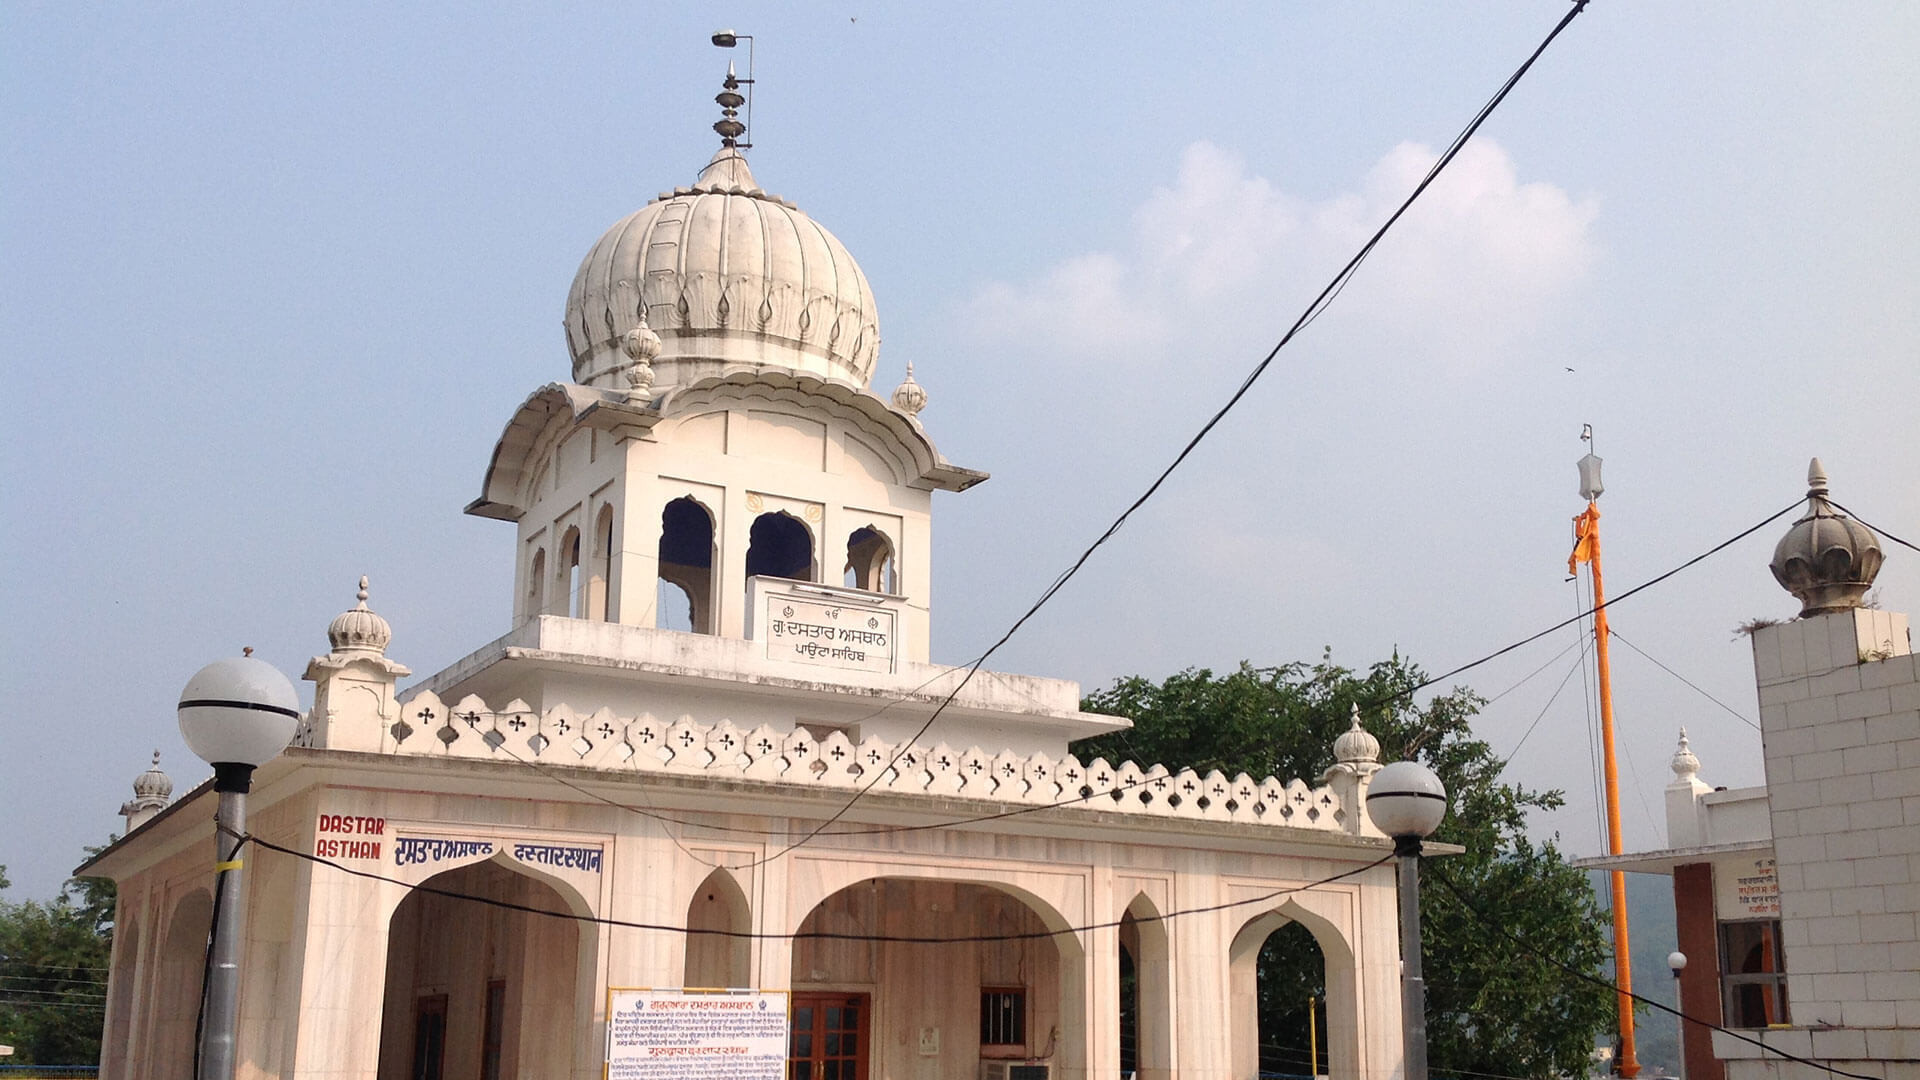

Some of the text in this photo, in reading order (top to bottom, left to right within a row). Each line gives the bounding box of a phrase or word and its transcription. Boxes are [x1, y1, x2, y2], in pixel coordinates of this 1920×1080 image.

[839, 628, 887, 647] ਅਸਥਾਨ
[831, 646, 865, 661] ਸਾਹਿਬ
[320, 814, 385, 835] DASTAR
[316, 839, 381, 859] ASTHAN
